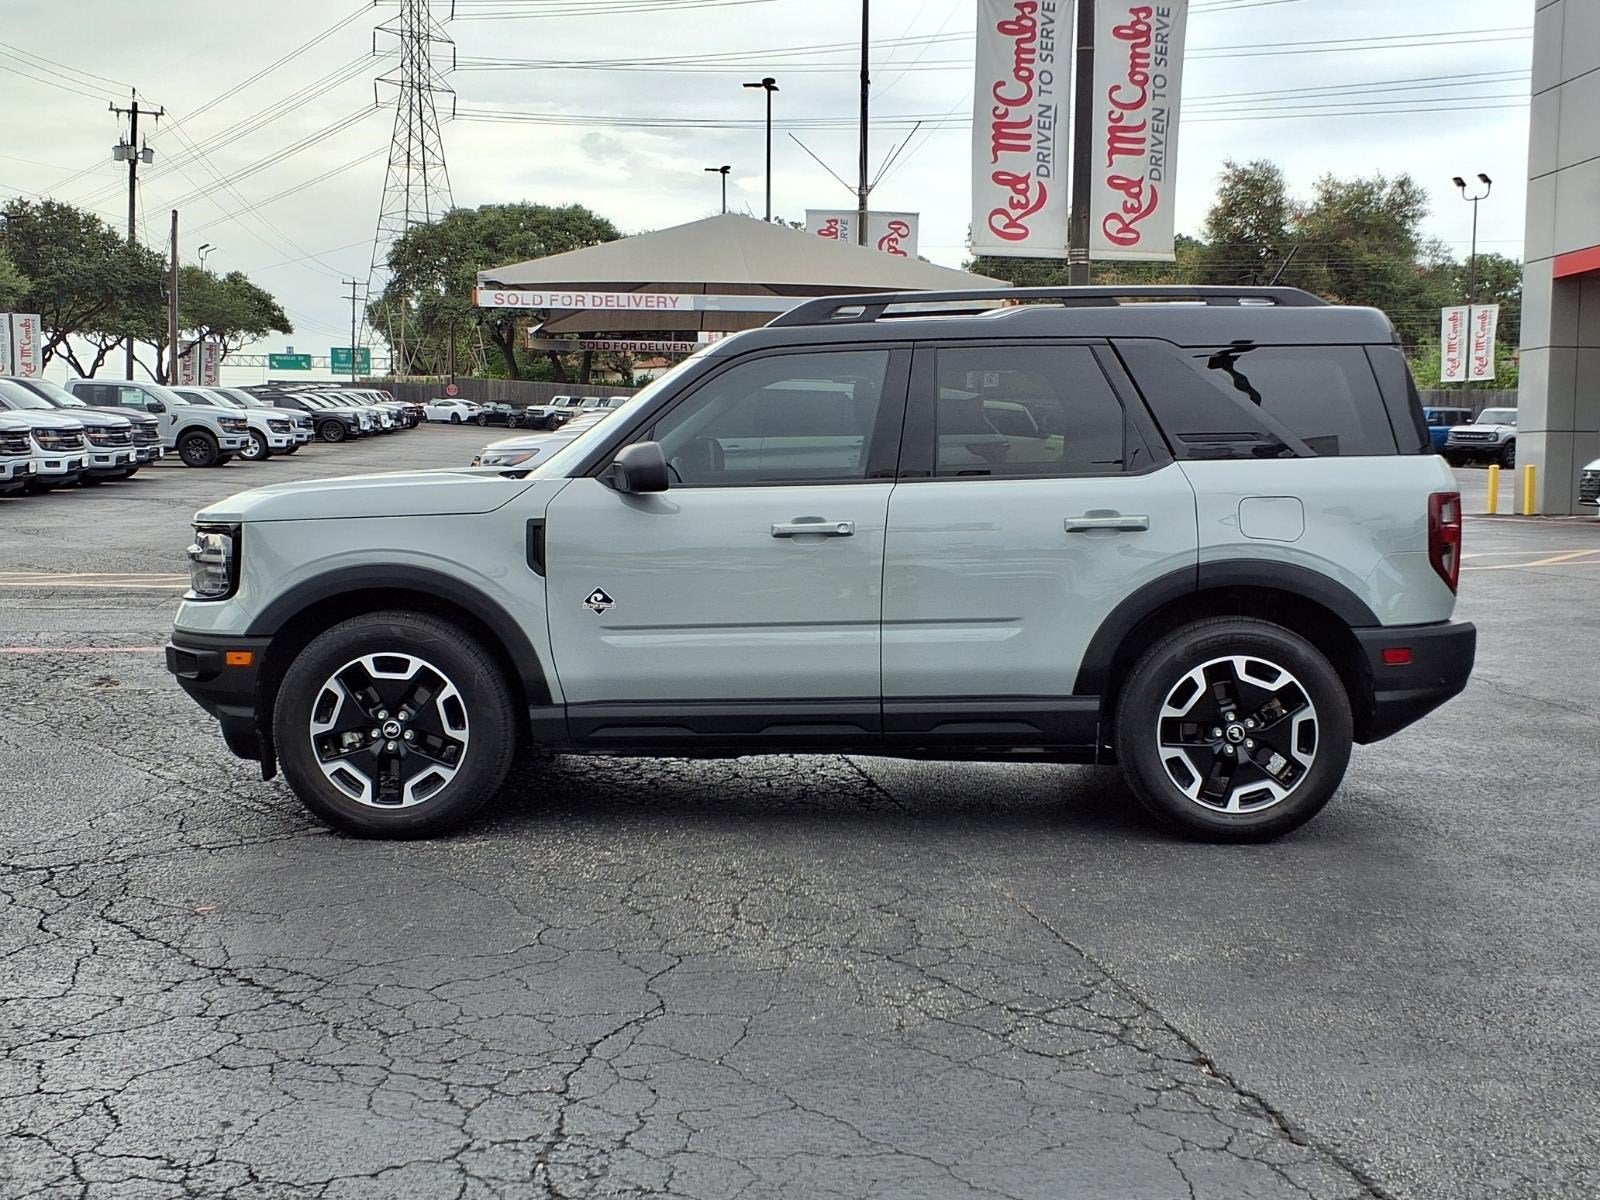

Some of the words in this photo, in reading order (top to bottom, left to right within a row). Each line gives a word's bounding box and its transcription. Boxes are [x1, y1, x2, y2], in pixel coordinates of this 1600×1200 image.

[1039, 1, 1056, 64] SERVE
[1154, 6, 1171, 69] SERVE
[991, 0, 1038, 164] McCombs
[1038, 69, 1054, 97] TO
[1106, 6, 1153, 169] McCombs
[1152, 74, 1167, 101] TO
[1036, 104, 1053, 179] DRIVEN
[1149, 107, 1165, 182] DRIVEN
[988, 170, 1048, 242] Red
[1103, 175, 1159, 247] Red
[878, 220, 910, 257] Red
[494, 293, 544, 307] SOLD
[550, 293, 586, 308] FOR
[591, 294, 680, 309] DELIVERY
[579, 341, 611, 351] SOLD
[614, 341, 637, 352] FOR
[639, 342, 695, 352] DELIVERY
